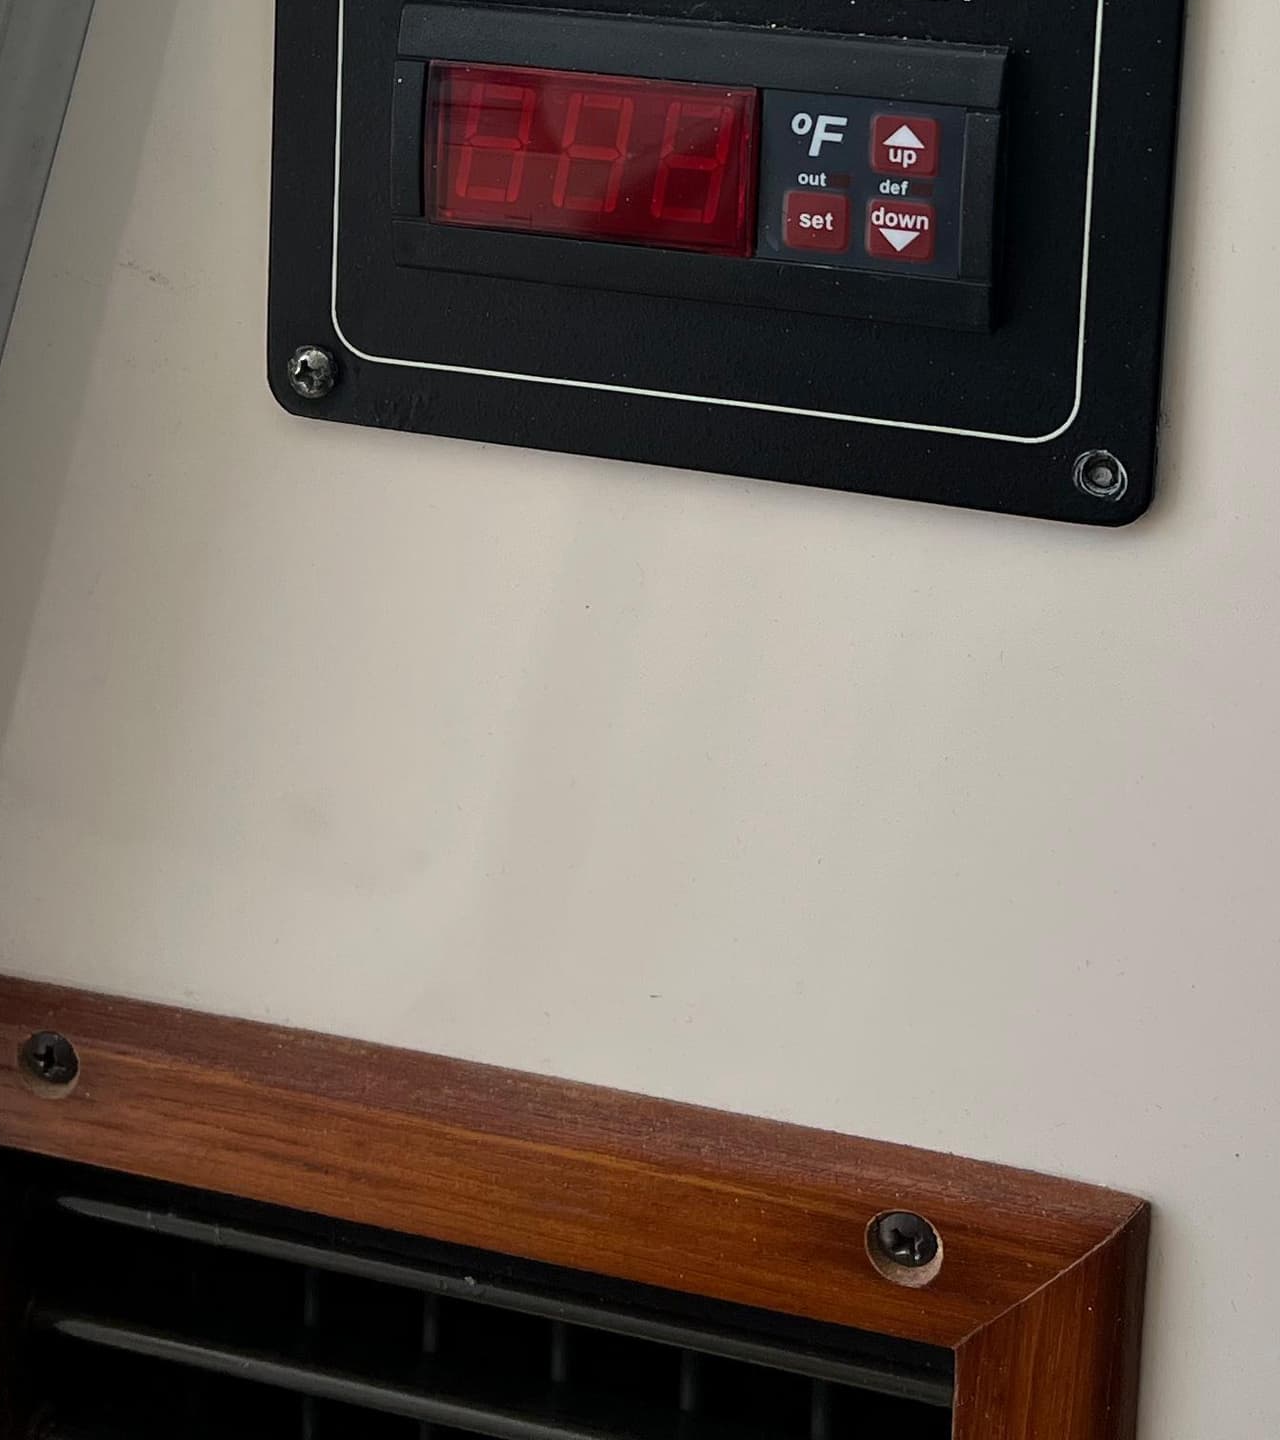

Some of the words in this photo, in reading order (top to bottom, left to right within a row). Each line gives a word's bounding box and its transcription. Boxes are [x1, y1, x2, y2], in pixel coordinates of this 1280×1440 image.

[888, 147, 917, 169] up
[797, 172, 827, 187] out
[879, 178, 909, 196] def
[799, 212, 834, 231] set
[871, 206, 929, 231] down
